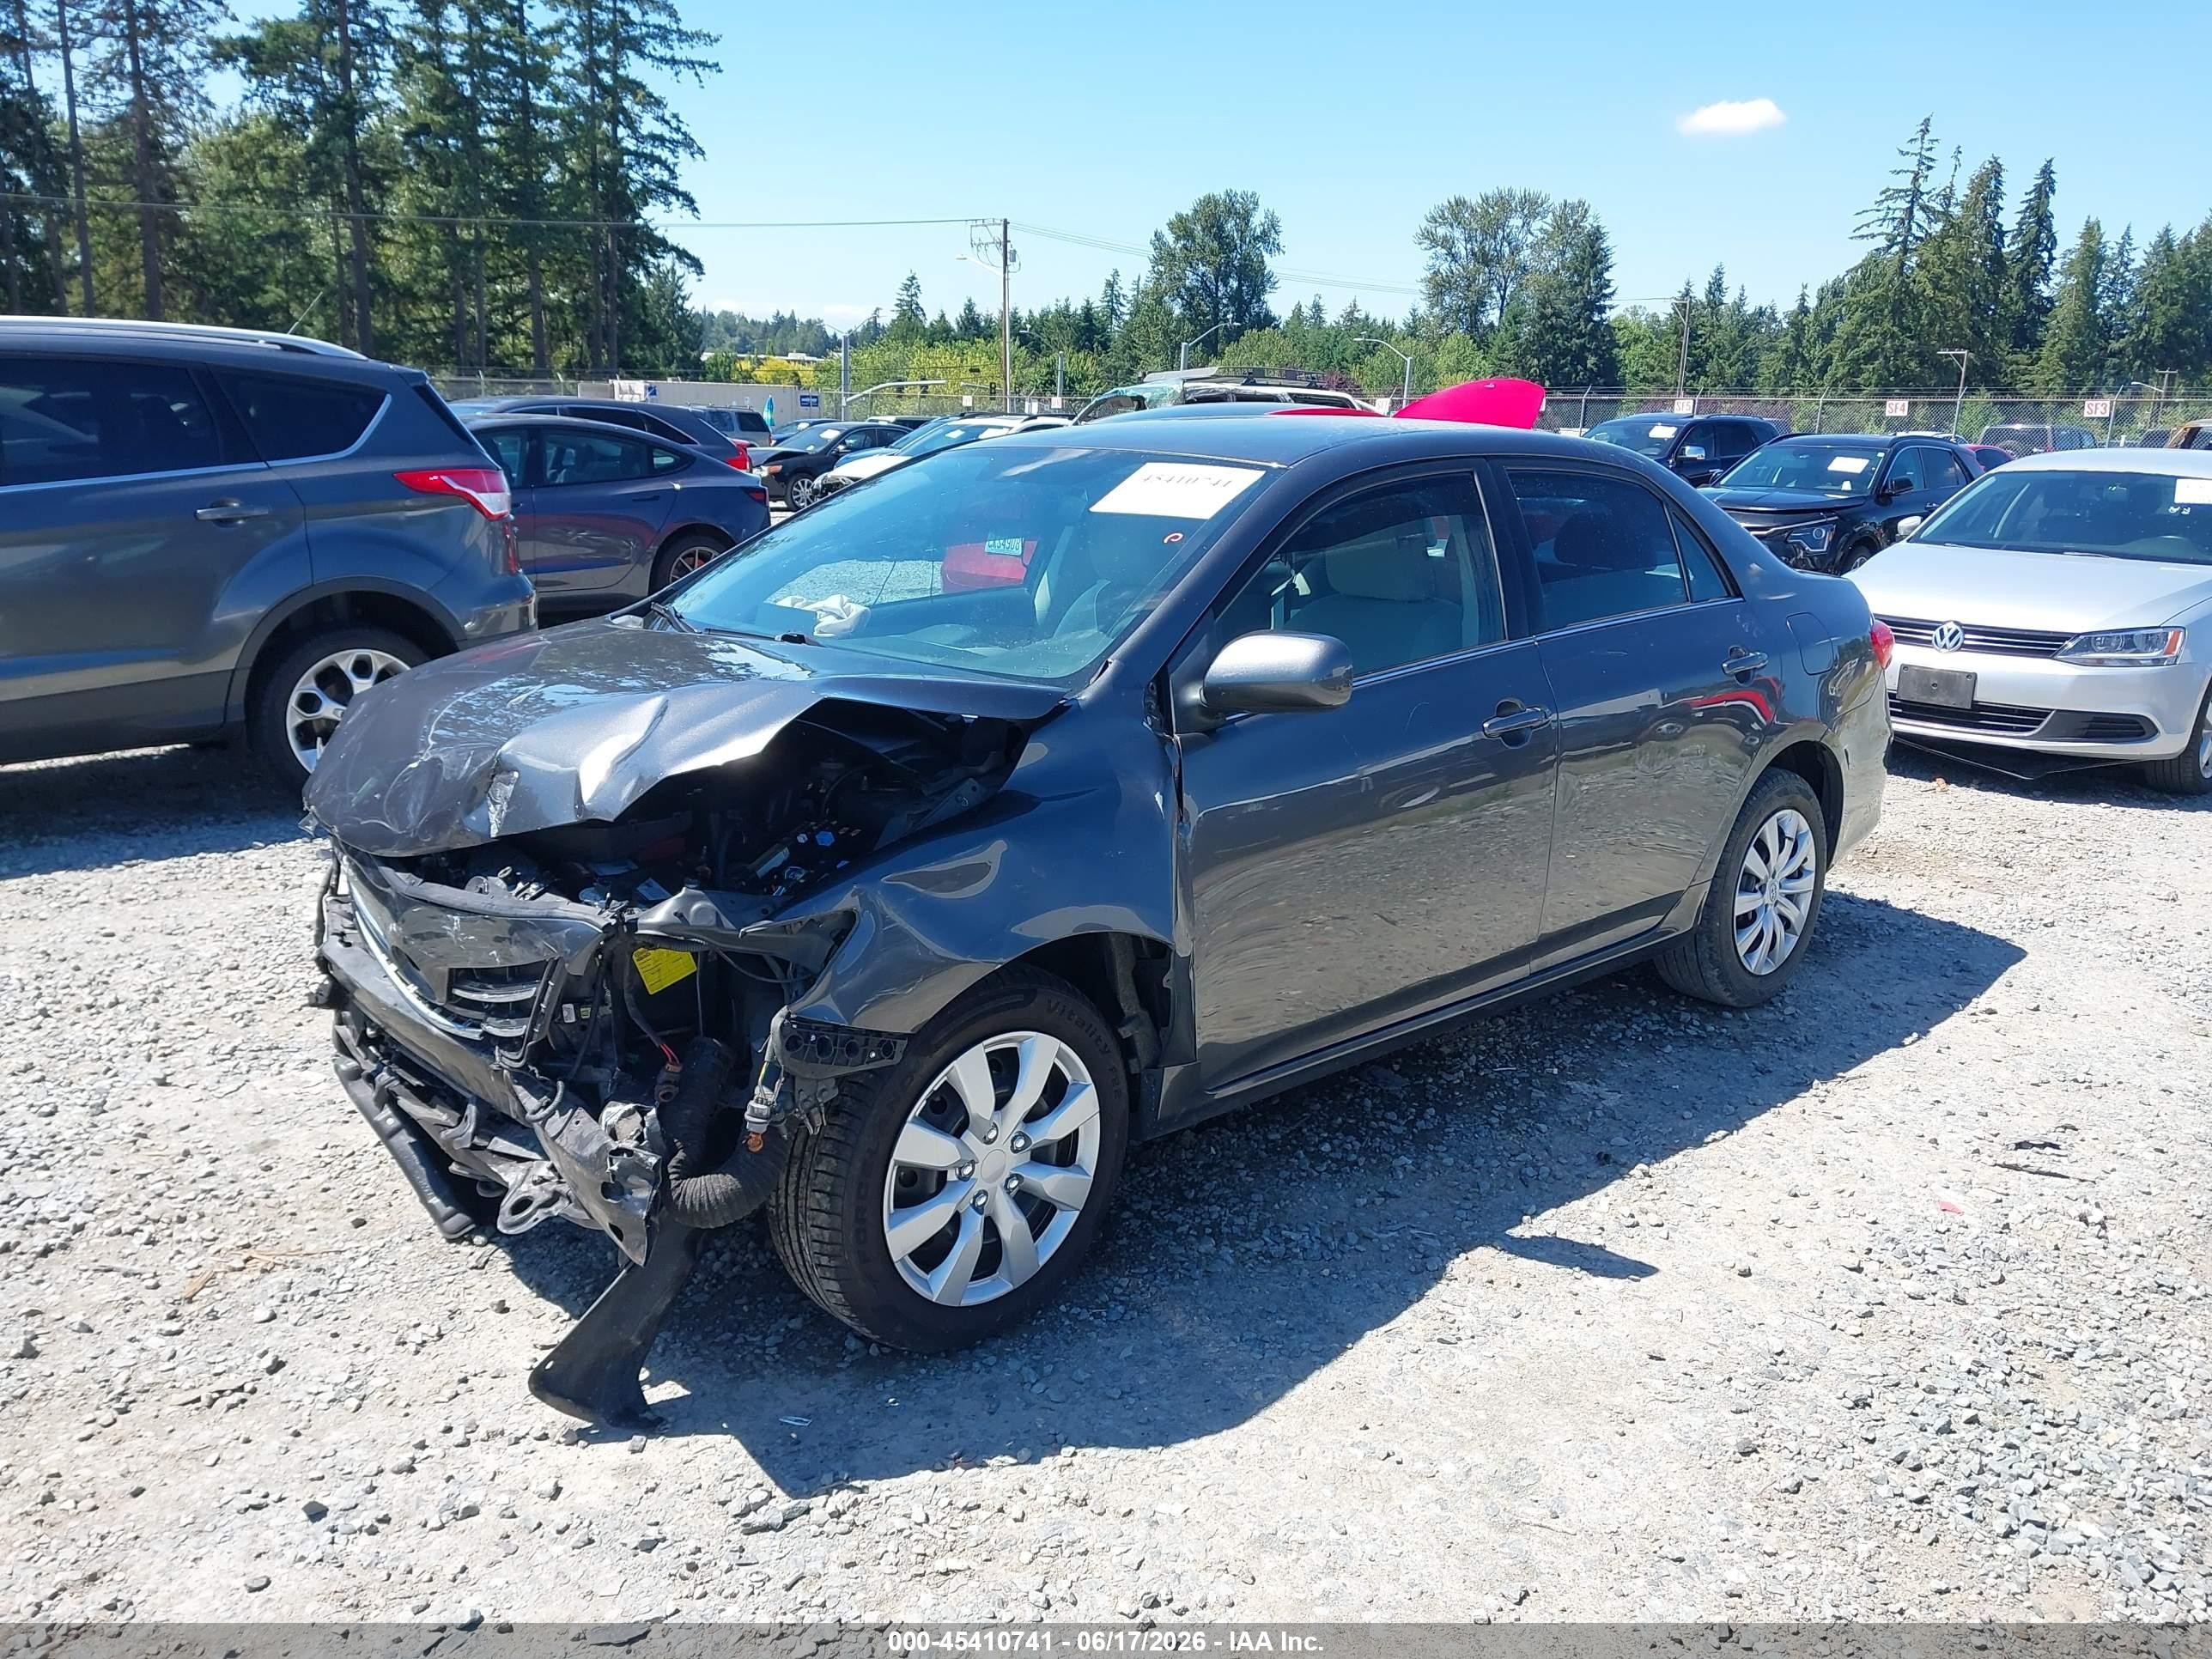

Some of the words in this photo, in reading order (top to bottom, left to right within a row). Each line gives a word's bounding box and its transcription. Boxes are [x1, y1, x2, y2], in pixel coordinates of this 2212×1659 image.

[1887, 402, 1905, 414] SF4
[2087, 402, 2108, 416] SF3
[1046, 998, 1111, 1055] Vitality
